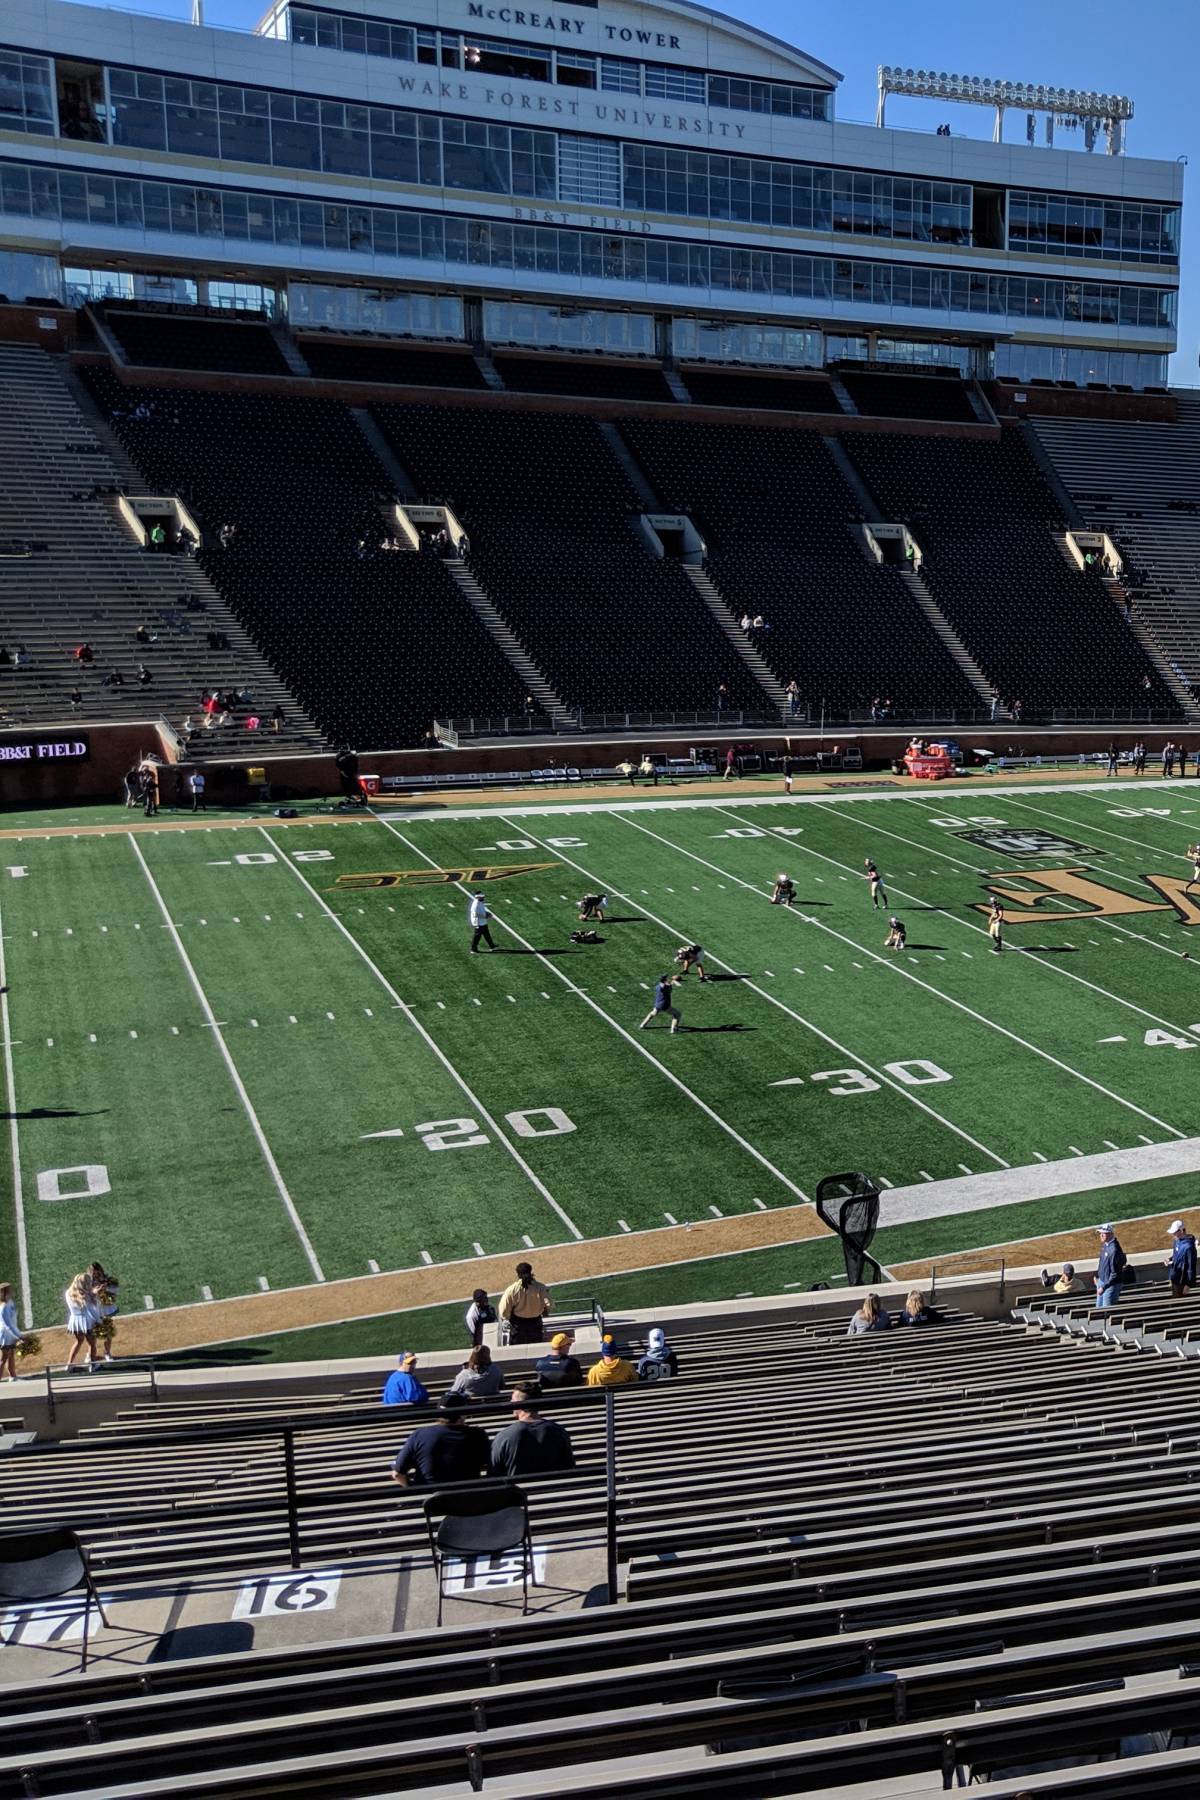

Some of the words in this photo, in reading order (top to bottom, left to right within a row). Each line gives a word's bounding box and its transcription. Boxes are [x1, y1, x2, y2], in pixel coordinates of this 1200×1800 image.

[468, 1, 585, 35] McCREARY
[605, 25, 682, 50] TOWER
[397, 76, 470, 101] WAKE
[485, 89, 580, 117] FOREST
[595, 105, 748, 139] UNIVERSITY
[514, 206, 570, 226] BB&T
[590, 215, 653, 234] FIELD
[38, 742, 87, 758] FIELD
[810, 1059, 953, 1096] 30
[415, 1107, 578, 1152] 20
[463, 1556, 535, 1590] 15
[248, 1574, 328, 1615] 16
